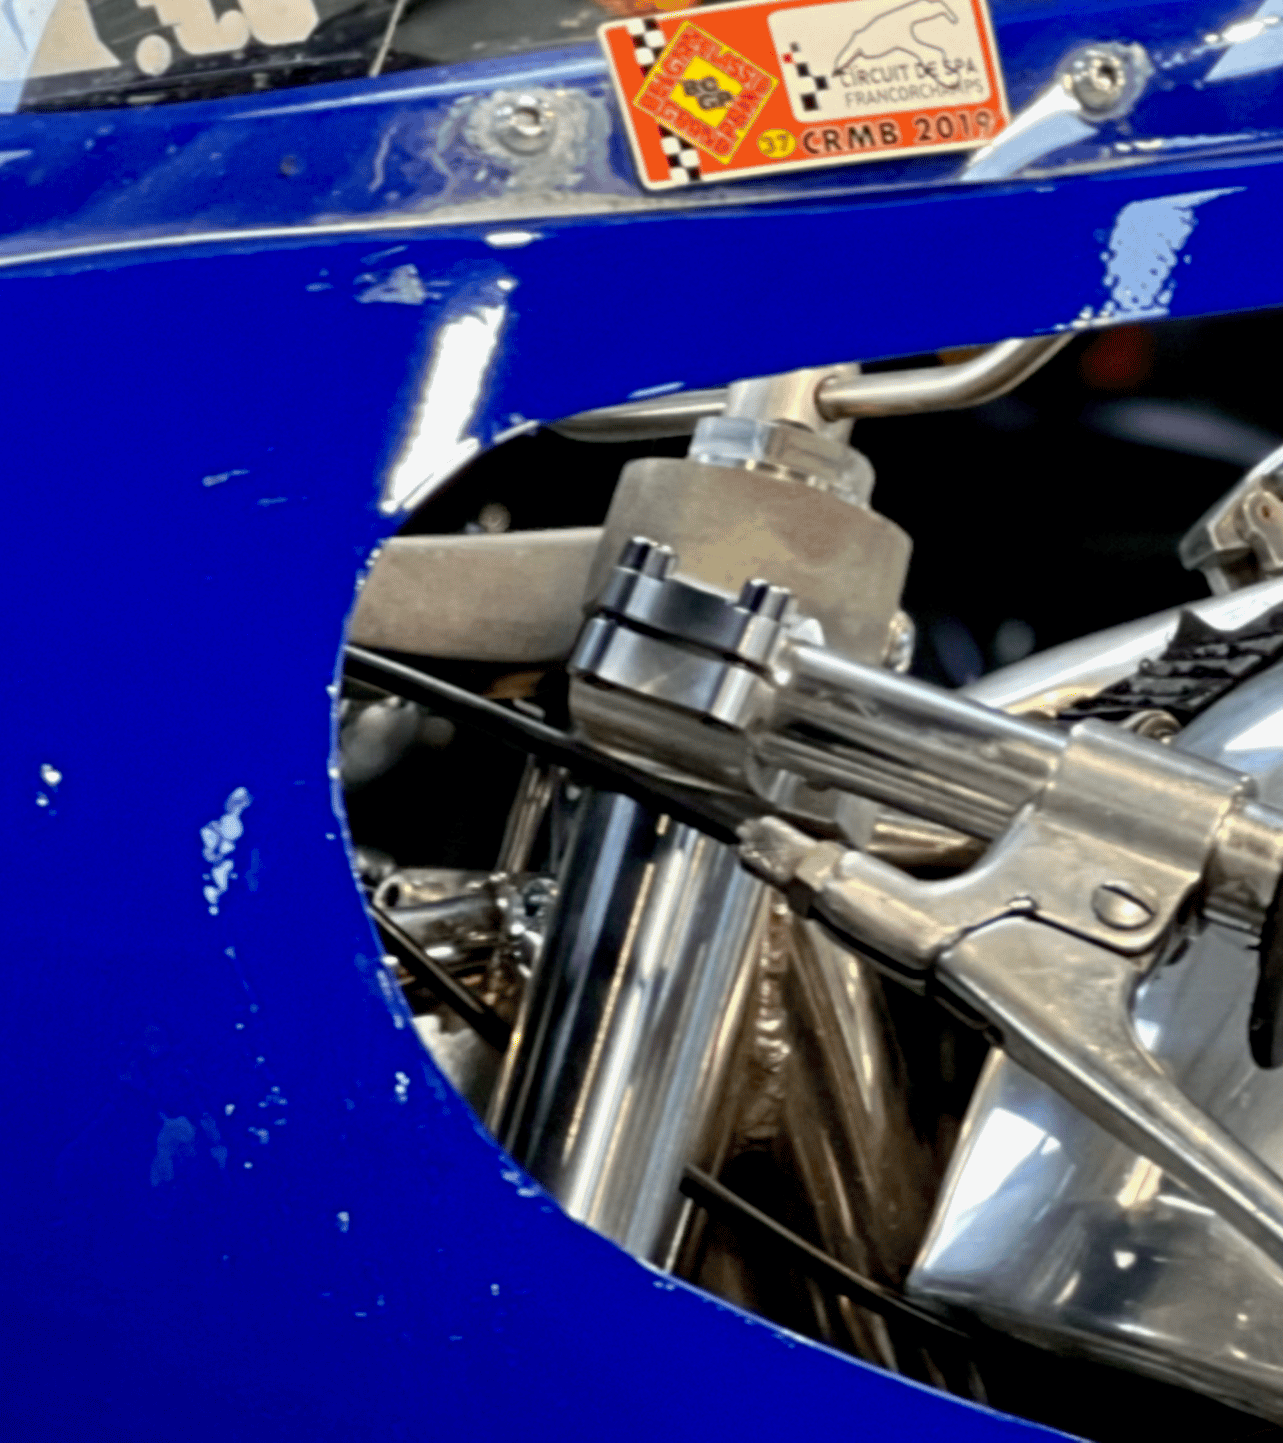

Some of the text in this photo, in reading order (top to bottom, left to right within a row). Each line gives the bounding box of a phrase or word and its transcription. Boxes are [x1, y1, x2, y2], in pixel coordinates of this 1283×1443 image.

[840, 56, 979, 89] CIRCUIT DE SPA
[843, 77, 985, 108] FRANCORCHAMPS
[760, 110, 992, 156] 37 CRMB 2019
